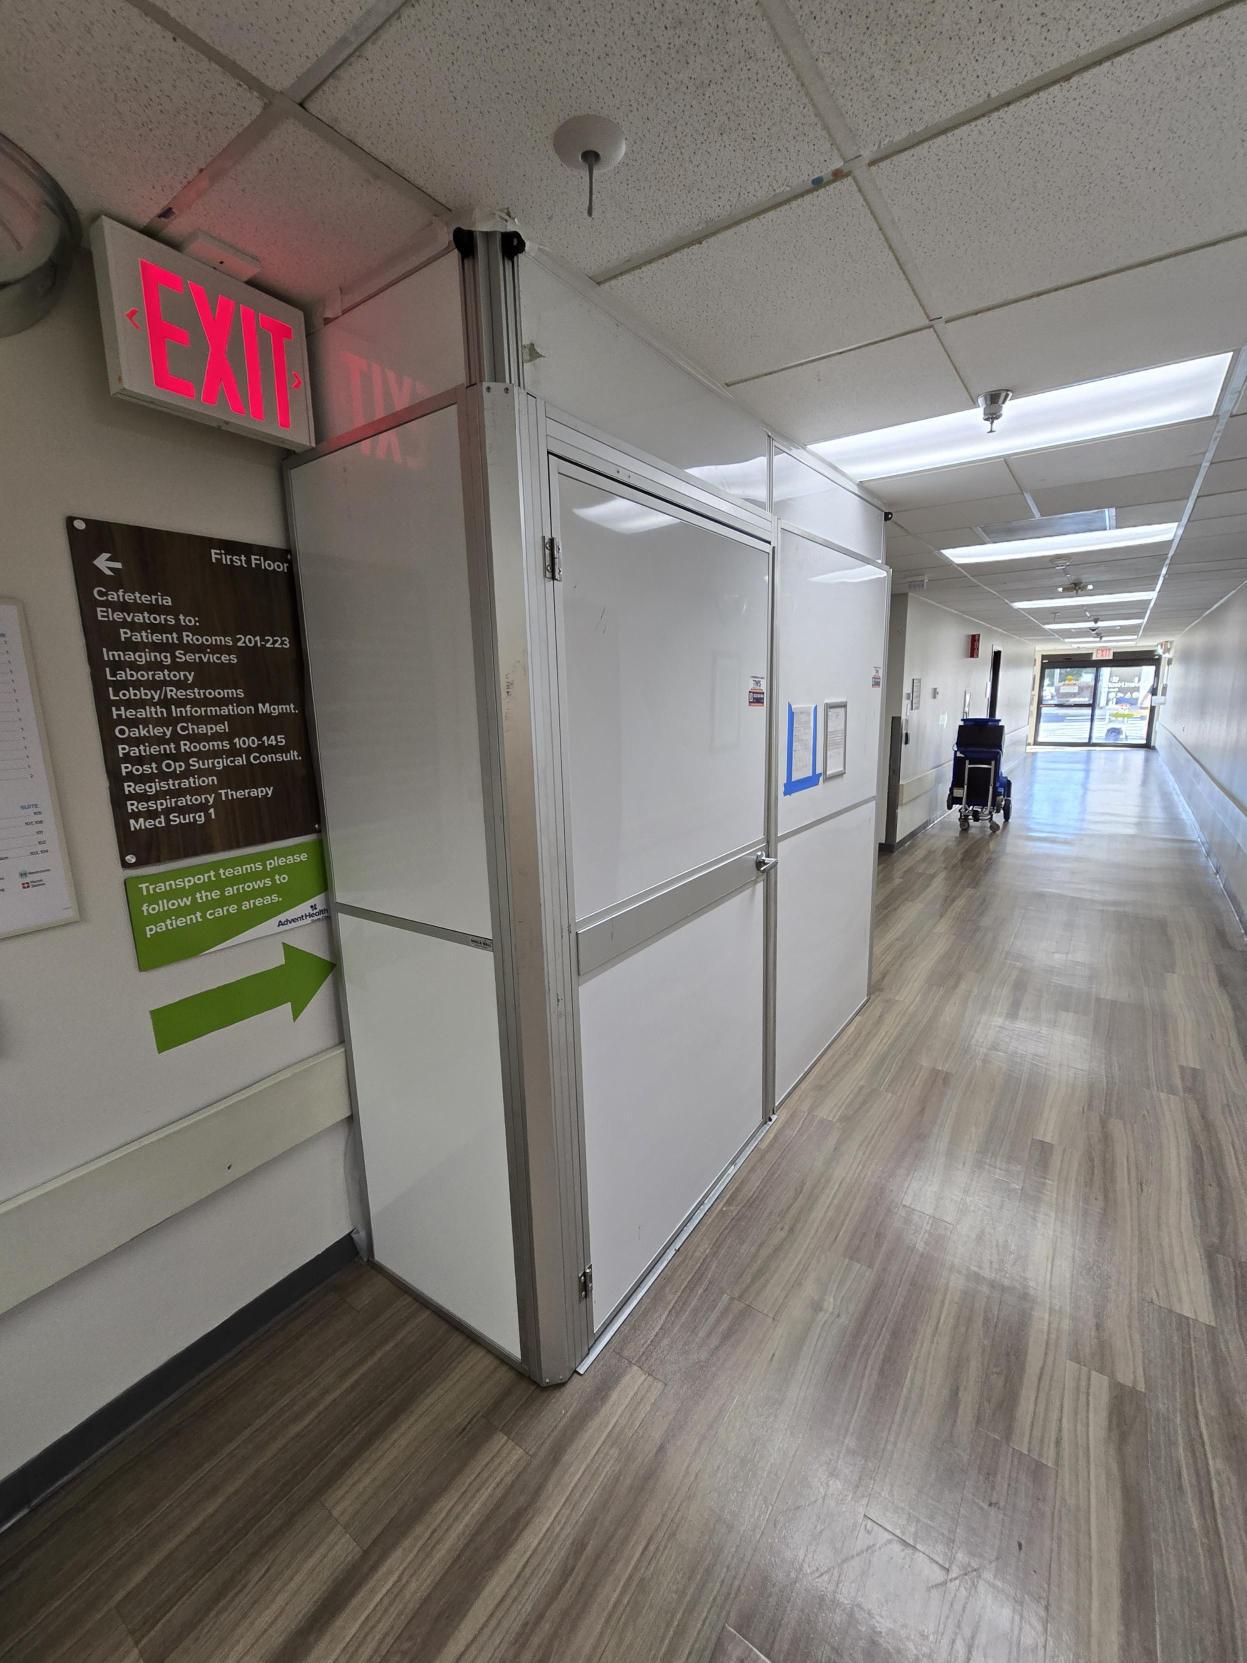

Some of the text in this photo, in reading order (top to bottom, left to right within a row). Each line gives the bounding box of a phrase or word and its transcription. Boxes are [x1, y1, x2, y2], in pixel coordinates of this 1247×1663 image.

[139, 259, 293, 430] EXIT
[211, 549, 289, 573] First Floor
[93, 587, 172, 606] Cafeteria
[97, 607, 199, 626] Elevators to:
[120, 629, 290, 648] Patient Rooms 201-223
[103, 648, 237, 664] Imaging Services
[106, 668, 194, 683] Laboratory
[109, 687, 244, 701] Lobby/Restrooms
[112, 703, 298, 719] Health Information Mgmt.
[115, 721, 228, 739] Oakley Chapel
[118, 735, 285, 757] Patient Rooms 100-145
[121, 750, 301, 775] Post Op Surgical Consult.
[124, 776, 217, 795] Registration
[127, 786, 273, 813] Respiratory Therapy
[130, 809, 215, 831] Med Surg 1
[138, 853, 308, 895] Transport teams please
[142, 873, 288, 915] follow the arrows to
[145, 893, 282, 938] patient care areas.
